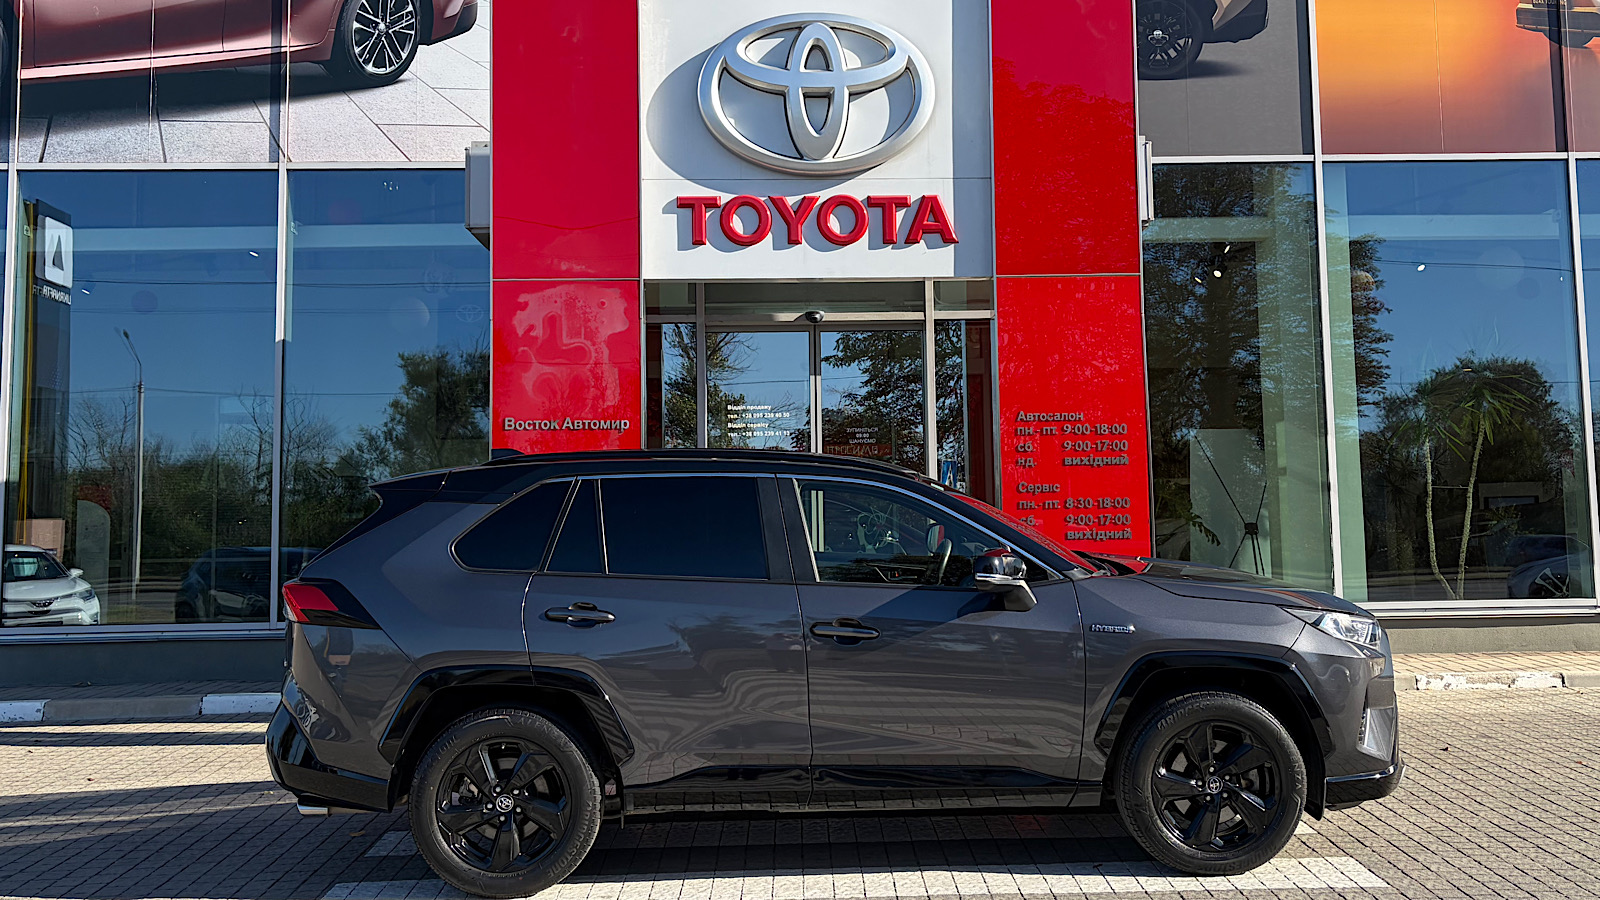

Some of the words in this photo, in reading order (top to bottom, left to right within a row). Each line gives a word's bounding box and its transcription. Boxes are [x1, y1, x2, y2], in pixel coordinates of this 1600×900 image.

[677, 194, 959, 246] TOYOTA
[1017, 411, 1084, 421] Автосалон
[504, 417, 560, 430] Восток
[562, 417, 630, 434] Автомир
[1063, 423, 1128, 435] 9:00-18:00
[1063, 440, 1129, 451] 9:00-17:00
[1017, 457, 1037, 467] нд.
[1064, 454, 1129, 467] вихідний
[1019, 481, 1061, 495] Сервіс
[1065, 497, 1131, 509] 8:30-18:00
[1066, 513, 1132, 526] 9:00-17:00
[1067, 528, 1132, 541] вихідний
